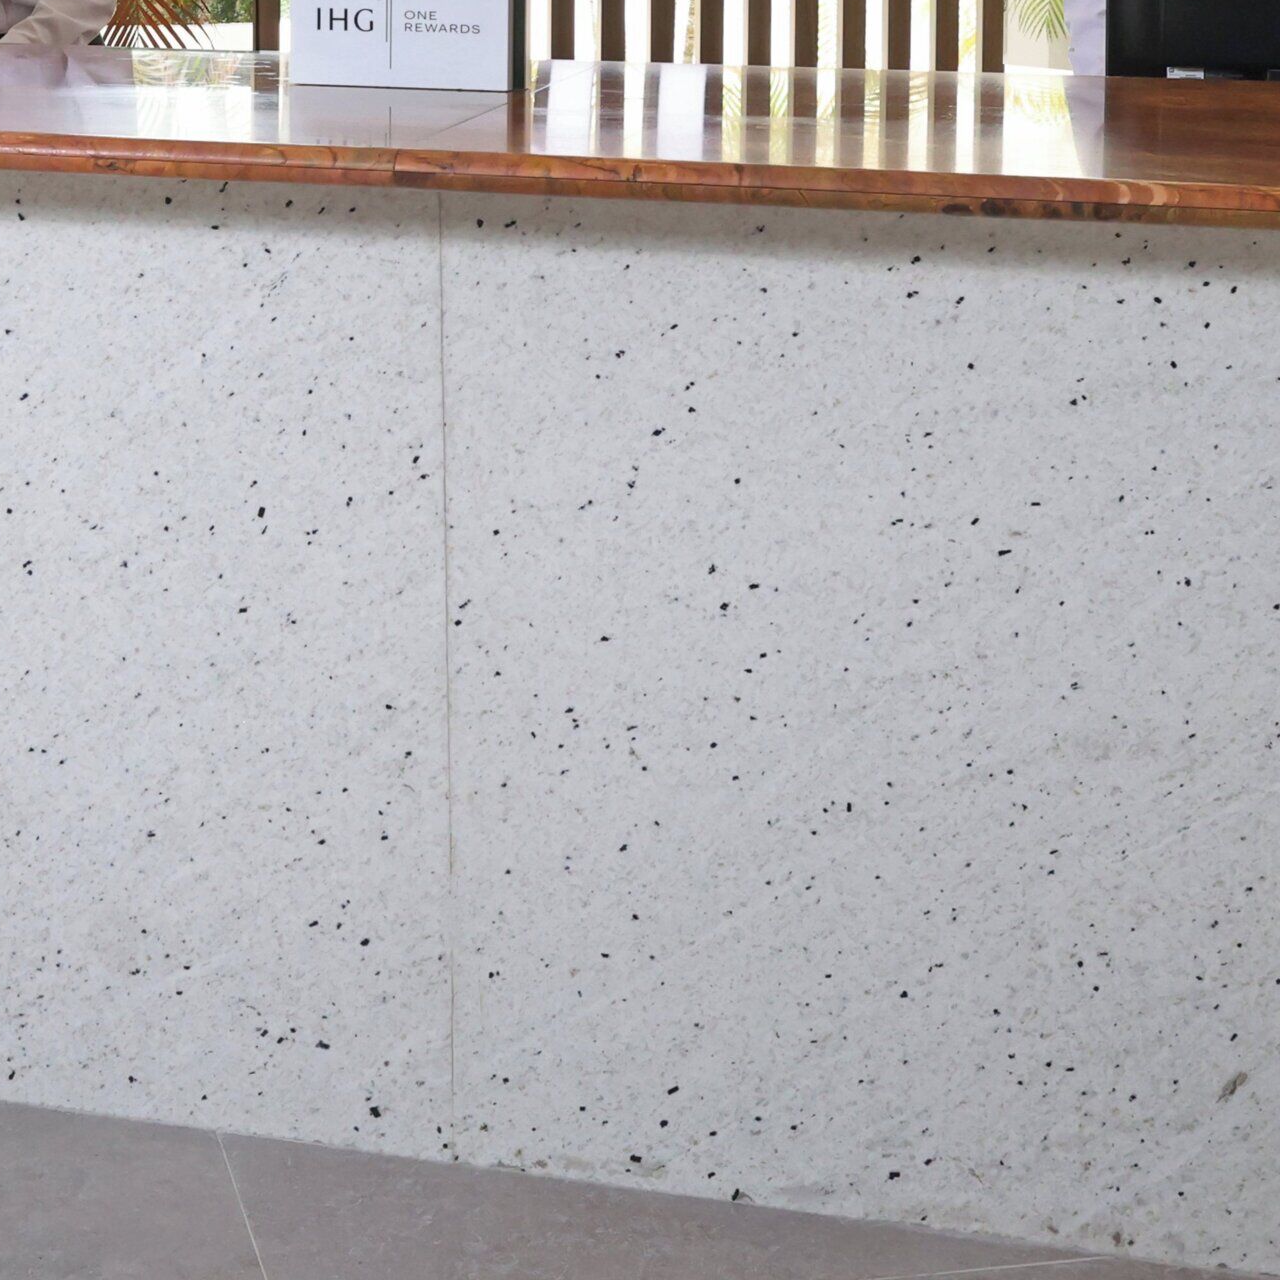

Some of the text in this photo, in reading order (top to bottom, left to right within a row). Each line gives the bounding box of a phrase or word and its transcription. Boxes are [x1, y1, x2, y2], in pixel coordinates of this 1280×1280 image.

[316, 7, 374, 33] IHG
[404, 10, 438, 21] ONE
[404, 22, 481, 35] REWARDS
